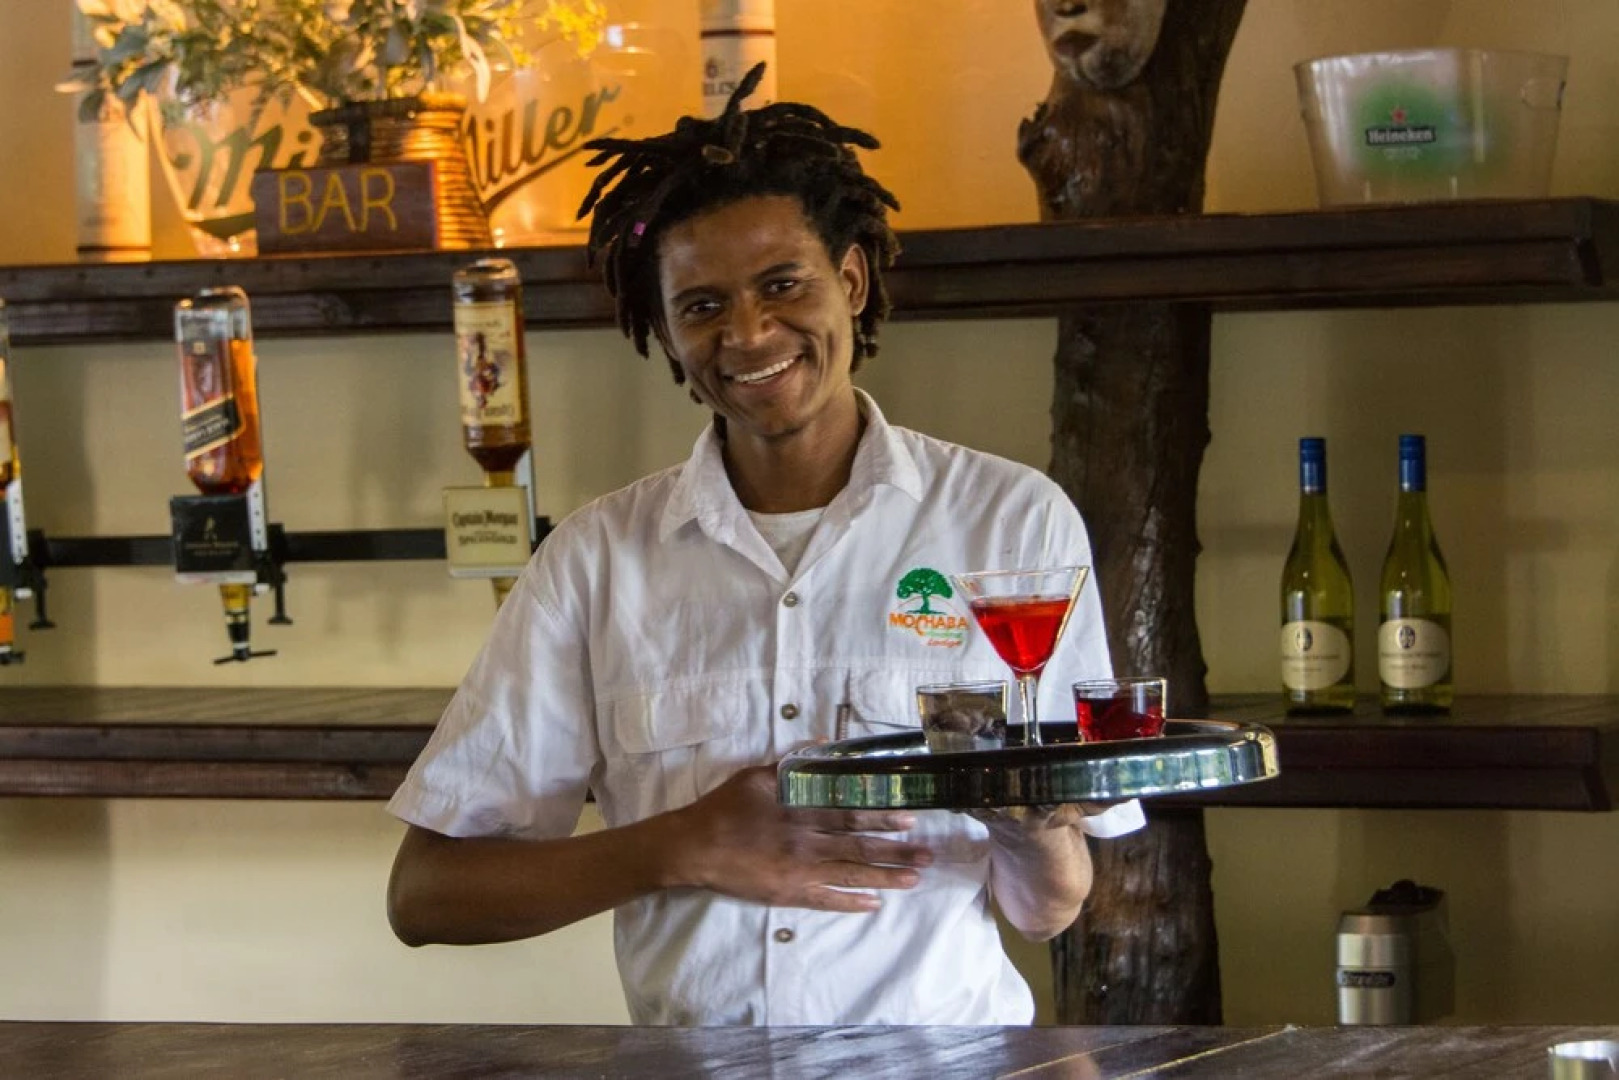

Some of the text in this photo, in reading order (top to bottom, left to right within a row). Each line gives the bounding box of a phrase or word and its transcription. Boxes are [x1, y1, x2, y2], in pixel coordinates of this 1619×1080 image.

[464, 84, 621, 192] iller
[1367, 127, 1432, 144] Heineken
[277, 167, 398, 235] BAR
[889, 612, 969, 636] MOCHABA
